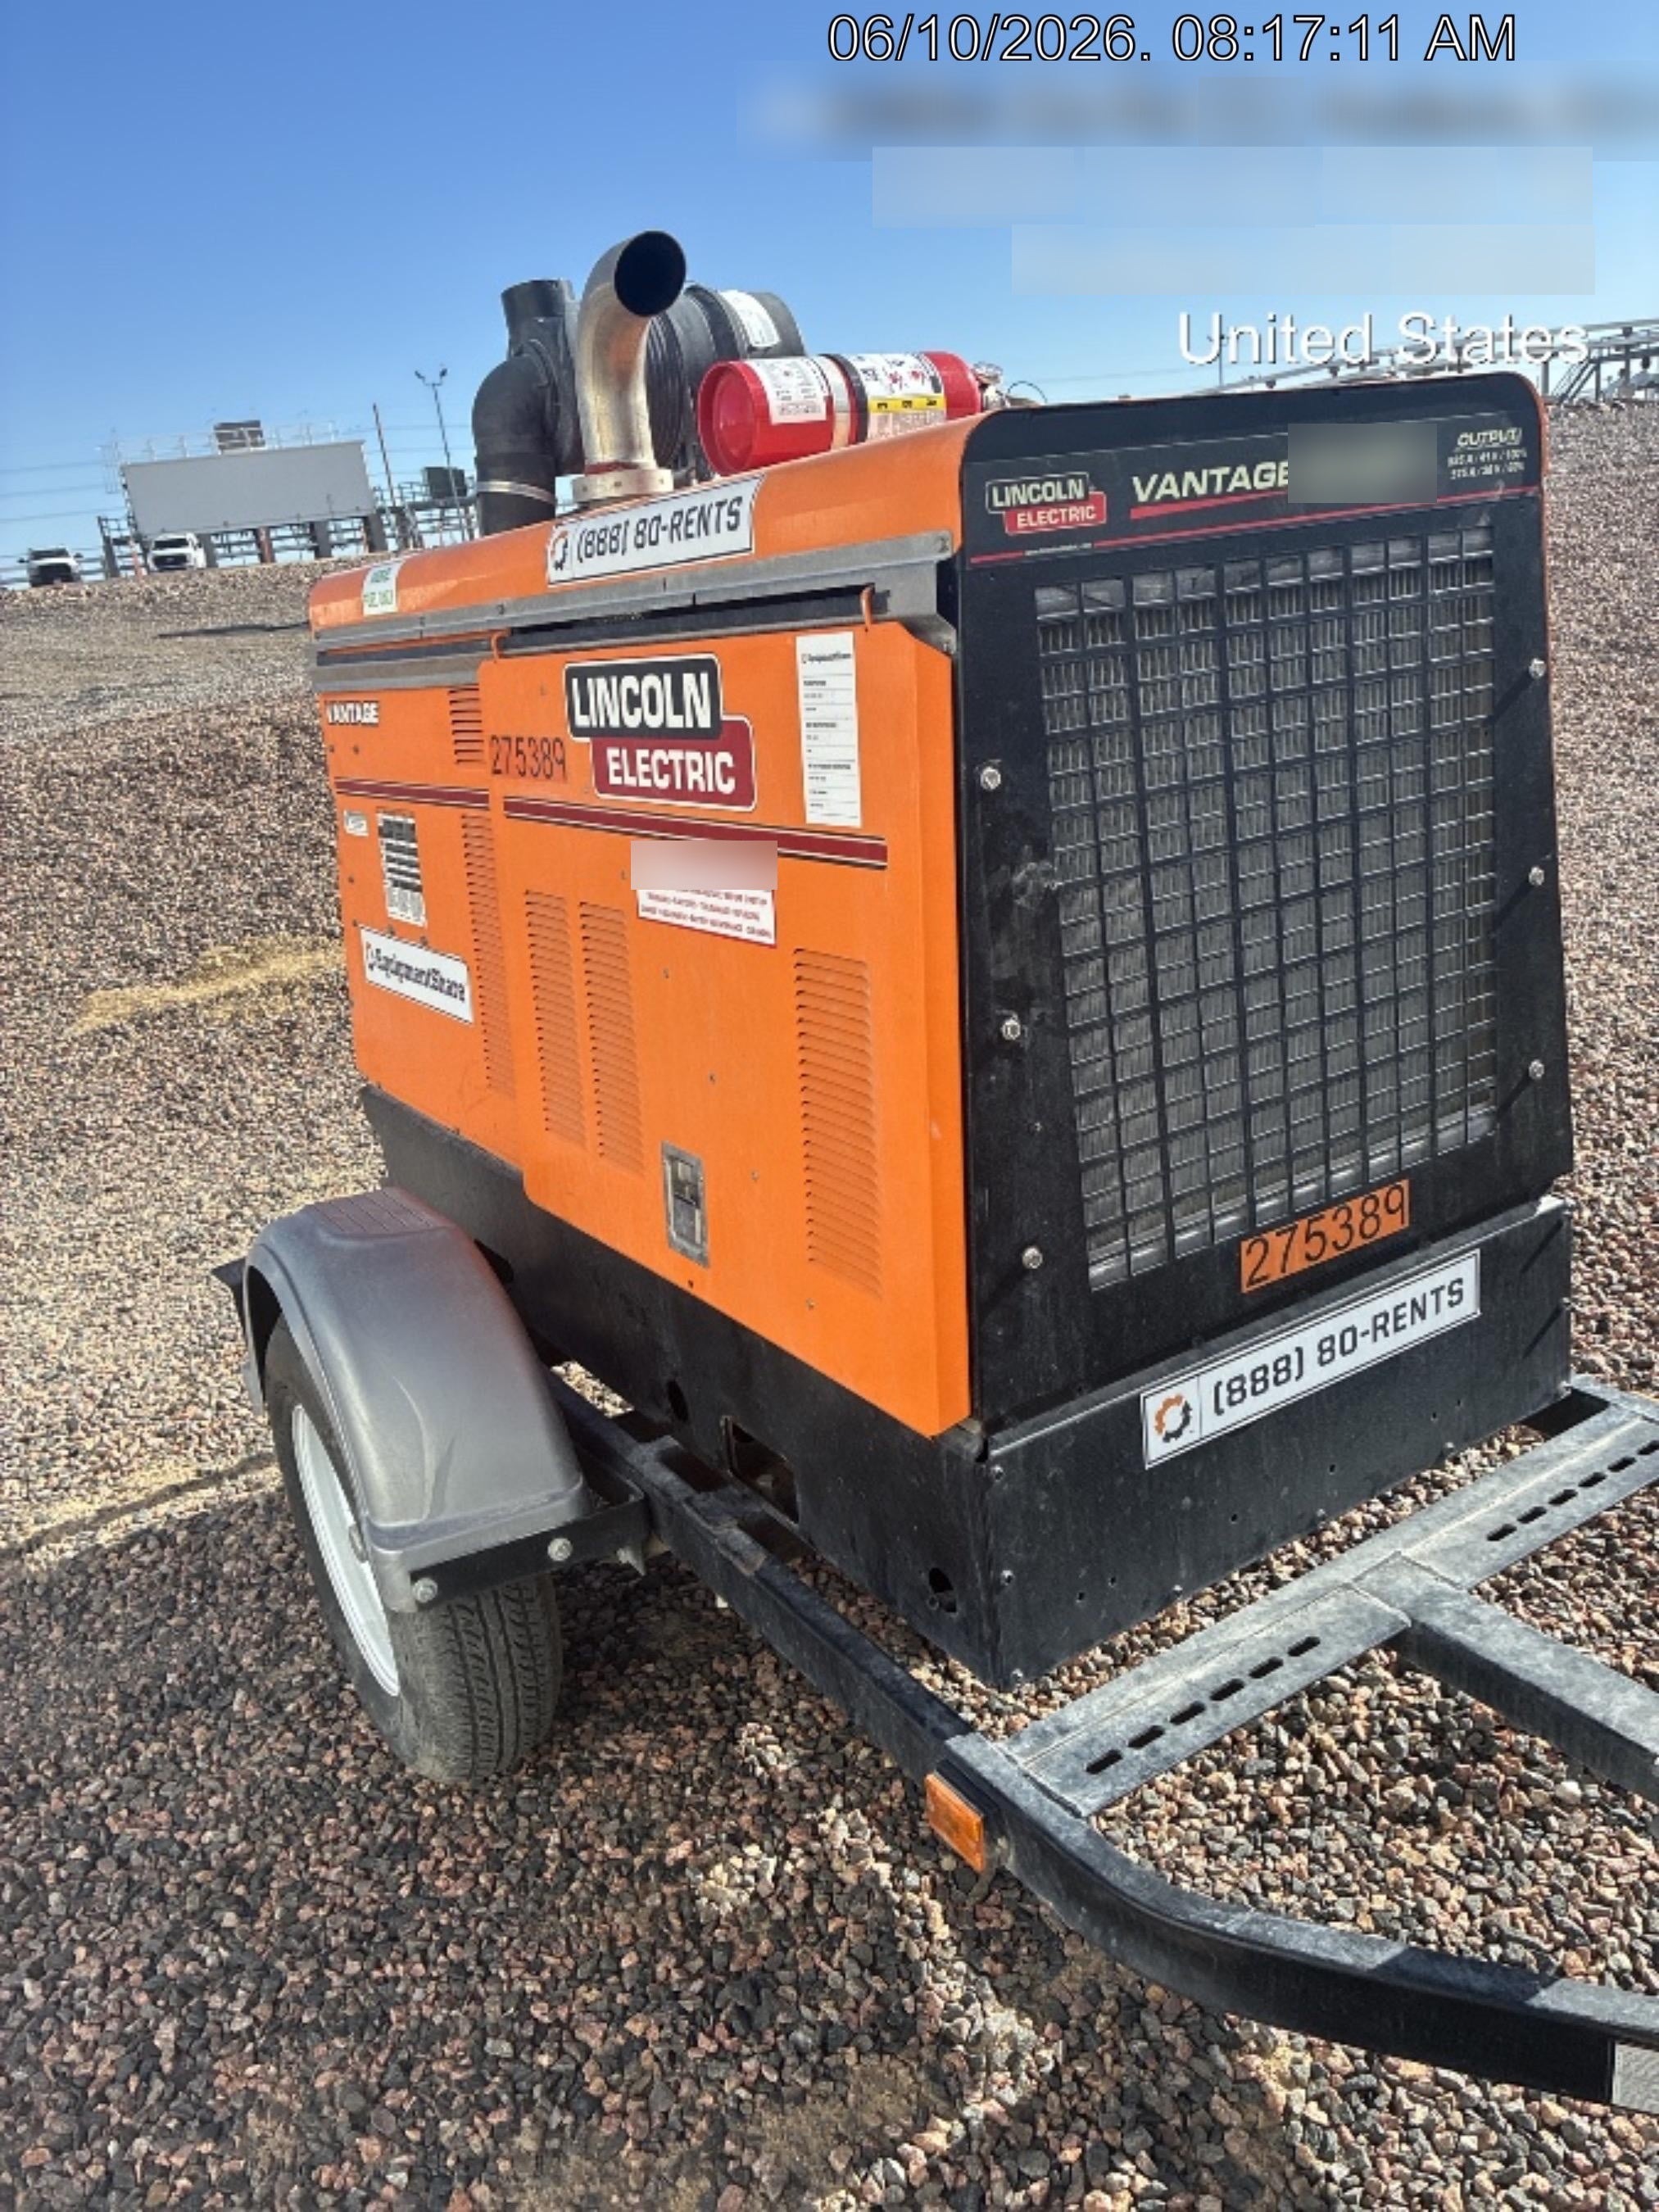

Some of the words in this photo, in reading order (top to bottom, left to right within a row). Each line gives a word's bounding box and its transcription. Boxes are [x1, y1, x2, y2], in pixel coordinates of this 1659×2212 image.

[991, 478, 1086, 509] LINCOLN
[1016, 505, 1098, 528] ELECTRIC
[577, 518, 630, 563] (888)
[633, 496, 743, 550] 80-RENTS
[572, 672, 712, 728] LINCOLN
[490, 736, 567, 779] 275389
[606, 746, 736, 795] ELECTRIC
[1245, 1183, 1406, 1286] 275389
[1213, 1346, 1304, 1415] (888)
[1317, 1276, 1464, 1367] 80-RENTS
